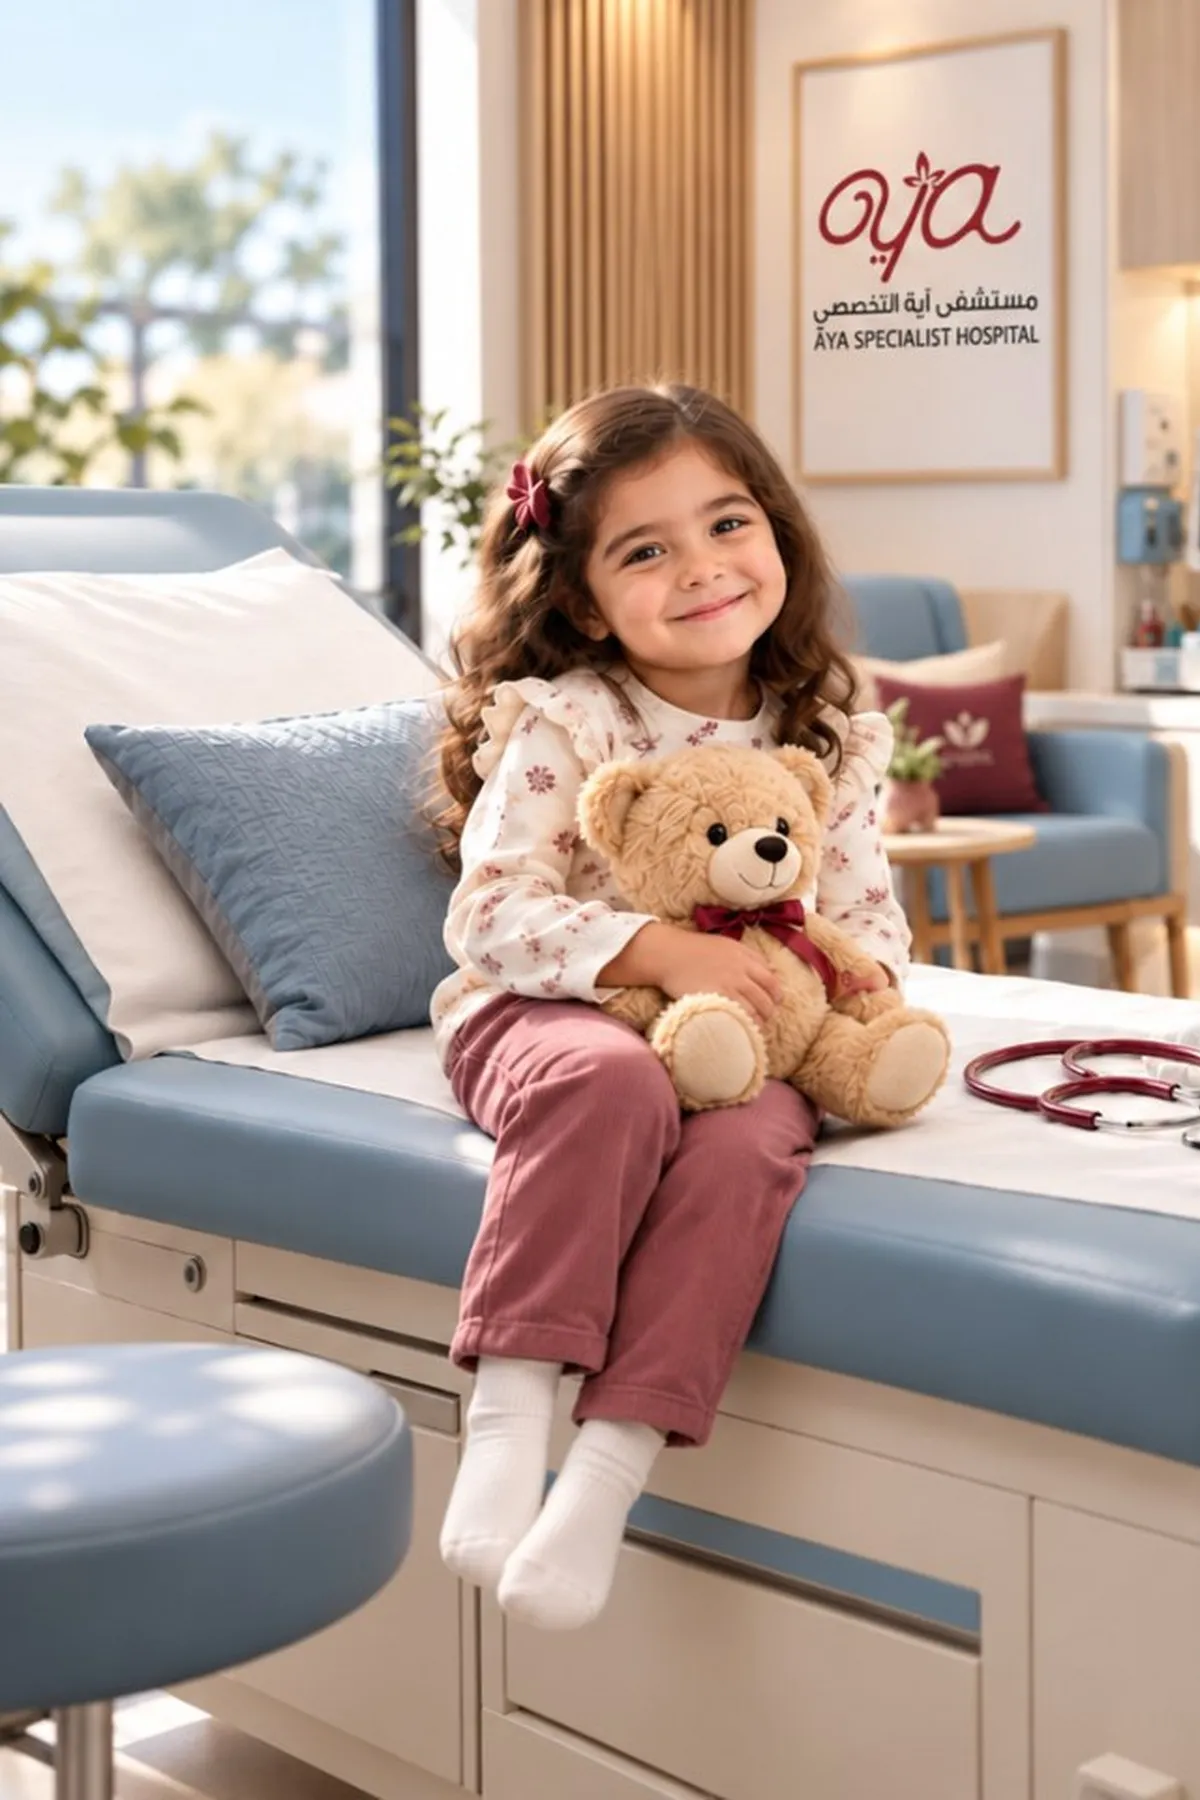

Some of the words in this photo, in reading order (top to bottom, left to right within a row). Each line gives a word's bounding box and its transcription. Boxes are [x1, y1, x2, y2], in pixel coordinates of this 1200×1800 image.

[935, 286, 1039, 319] مستشفى
[853, 327, 952, 350] SPECIALIST
[955, 324, 1040, 346] HOSPITAL
